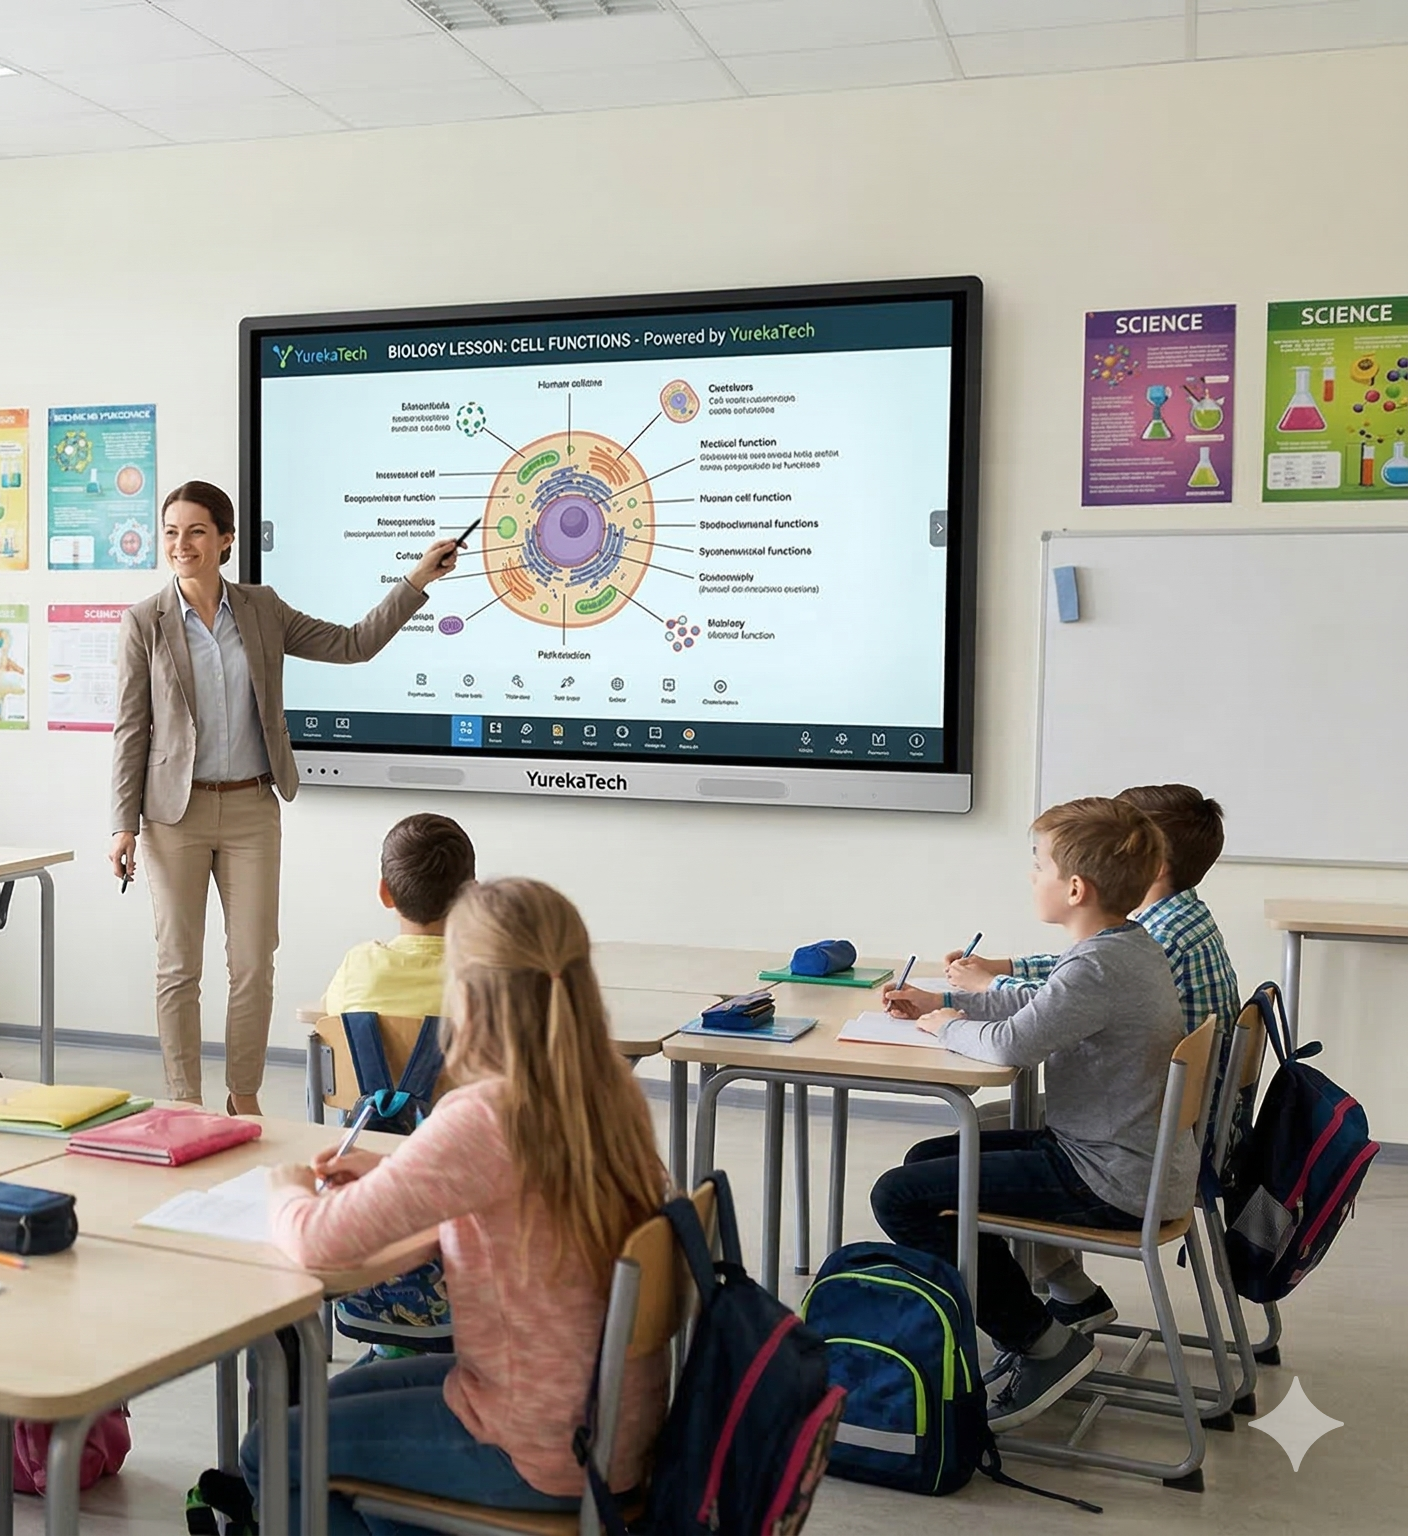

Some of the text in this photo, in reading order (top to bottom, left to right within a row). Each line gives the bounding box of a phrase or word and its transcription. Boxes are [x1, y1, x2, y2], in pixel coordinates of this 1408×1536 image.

[1115, 313, 1203, 334] SCIENCE
[1301, 304, 1393, 325] SCIENCE
[388, 343, 447, 360] BIOLOGY
[449, 340, 508, 357] LESSON:
[511, 336, 544, 352] CELL
[548, 332, 631, 351] FUNCTIONS
[644, 328, 705, 347] Powered
[709, 327, 726, 347] by
[730, 322, 815, 342] YurekaTech
[294, 346, 367, 363] YurekaTech
[739, 438, 777, 448] function
[753, 492, 792, 502] function
[774, 518, 819, 529] functions
[526, 771, 627, 791] YurekaTech
